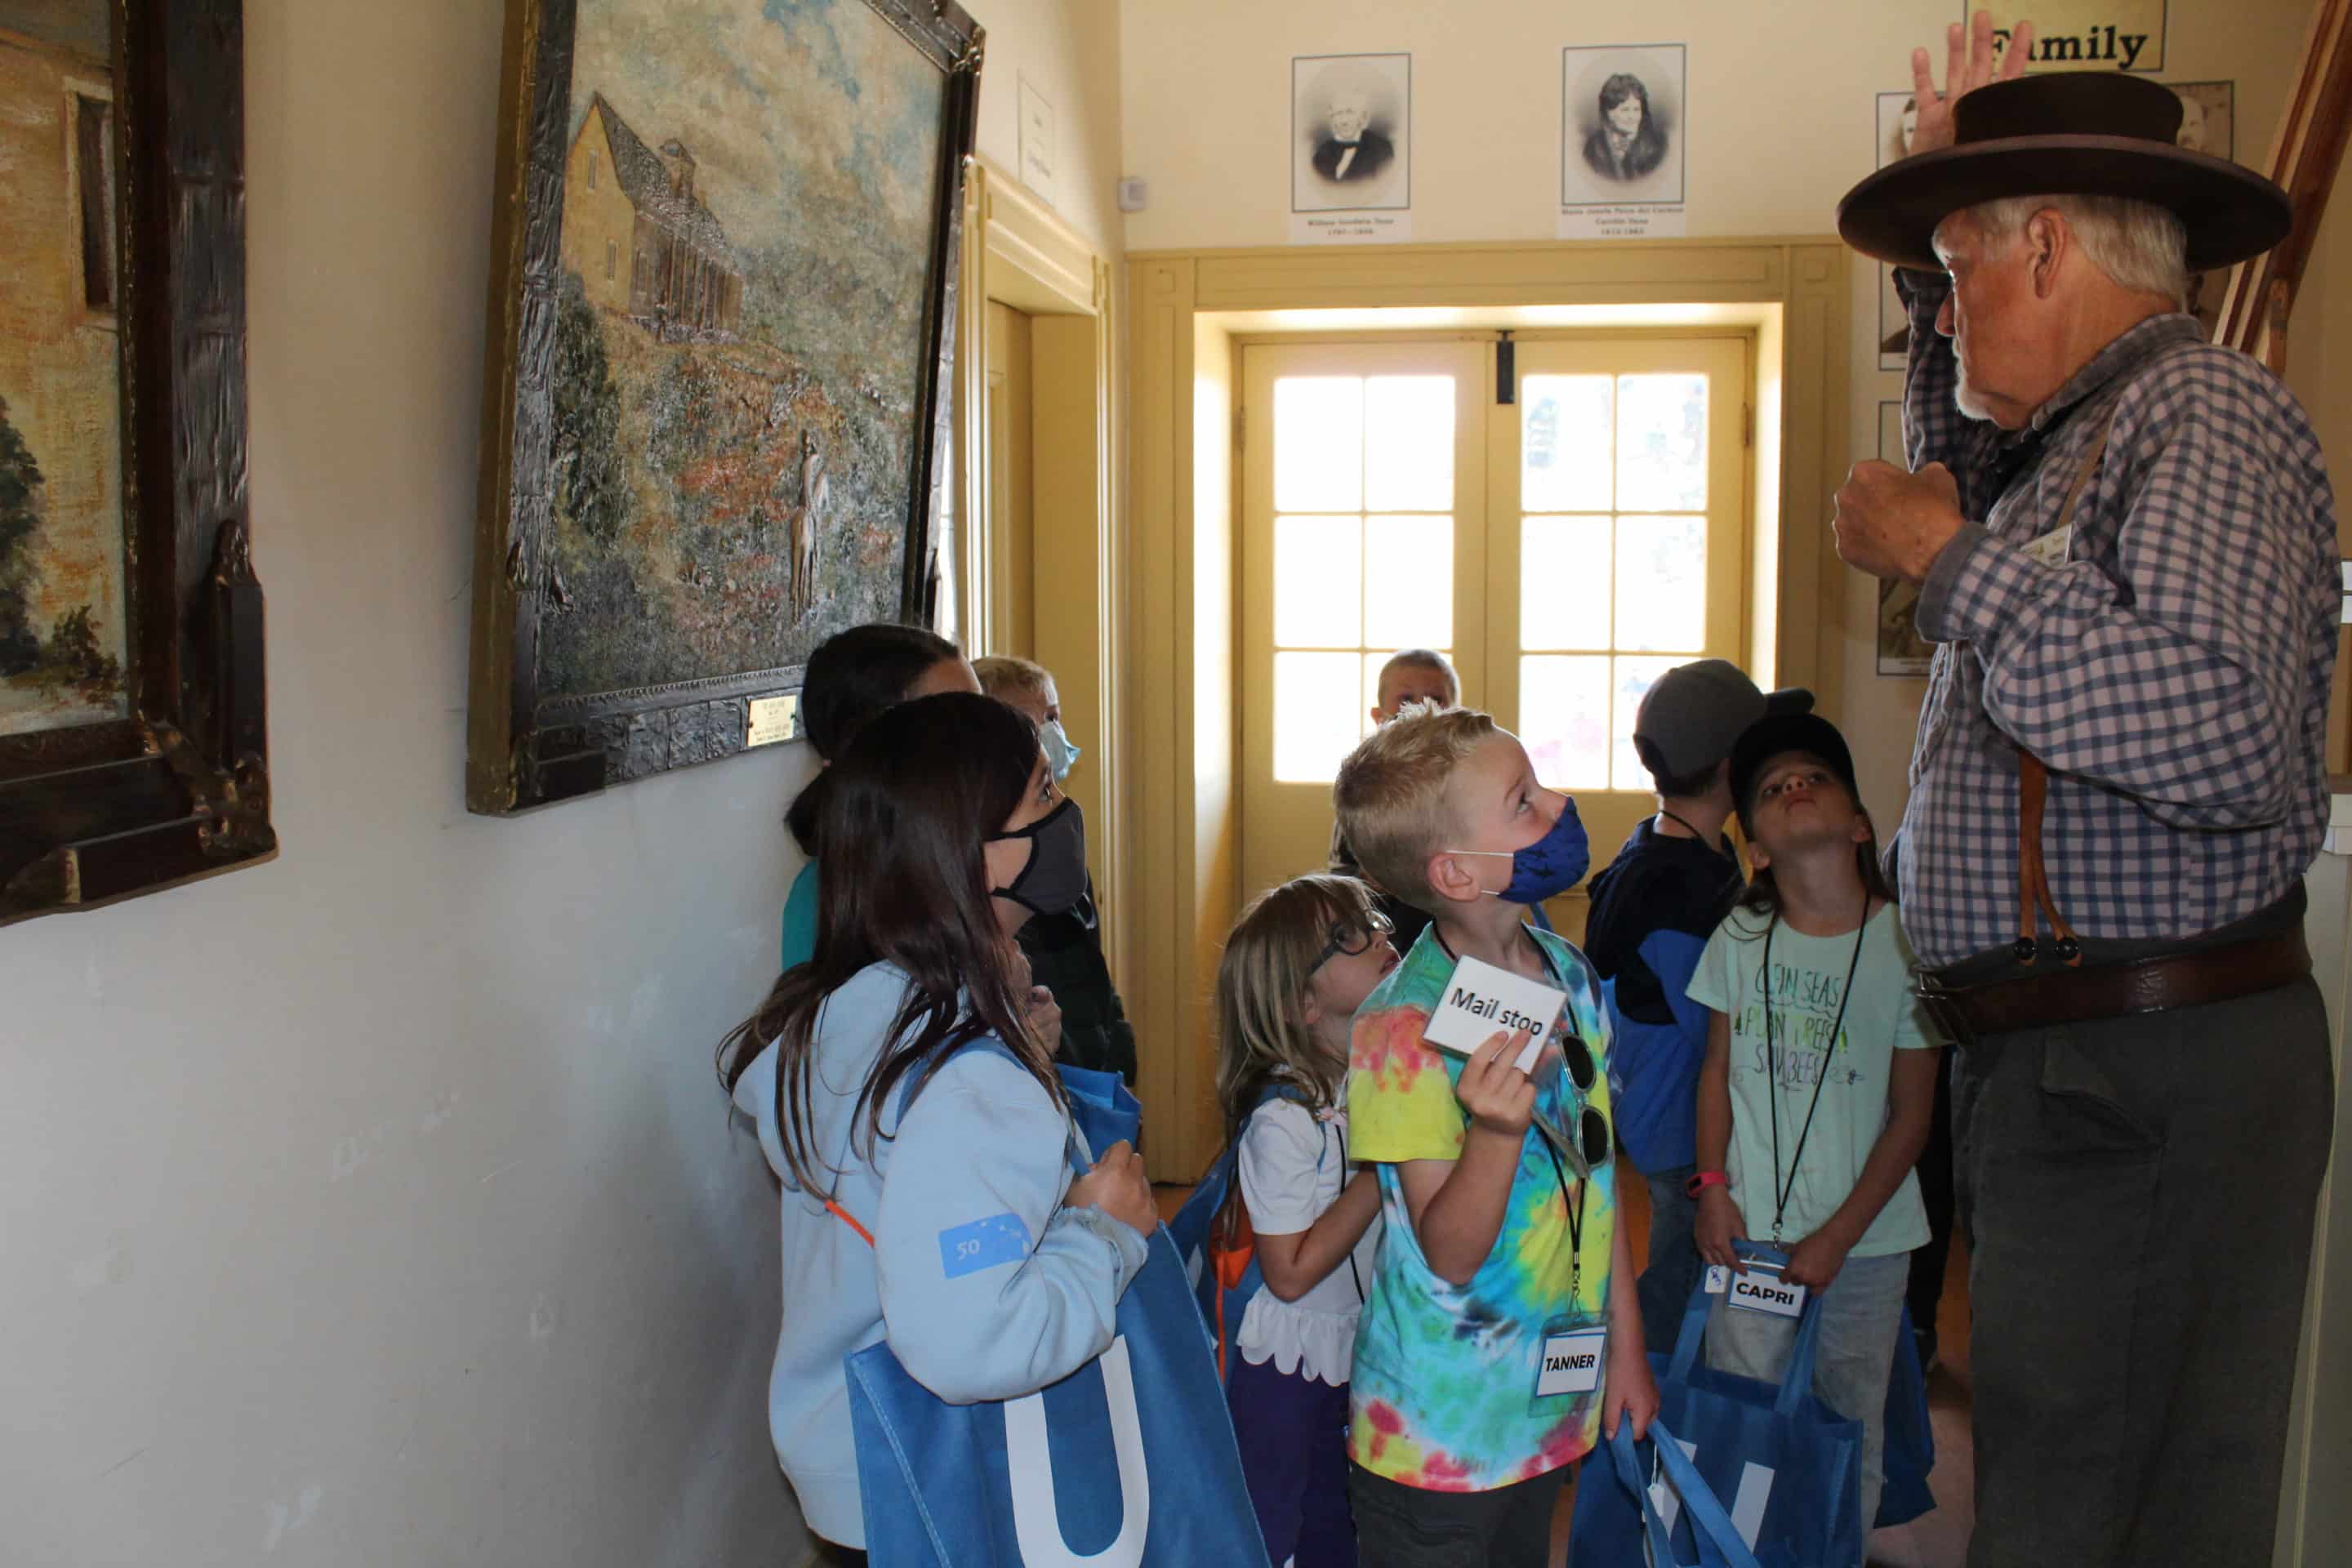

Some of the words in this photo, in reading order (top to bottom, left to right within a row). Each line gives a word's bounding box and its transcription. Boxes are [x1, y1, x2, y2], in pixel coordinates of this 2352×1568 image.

[1993, 24, 2147, 70] Fmily
[1450, 987, 1499, 1020] Mail
[1801, 971, 1842, 1007] SEAS
[1736, 1283, 1794, 1305] CAPRI
[1546, 1355, 1596, 1372] TANNER
